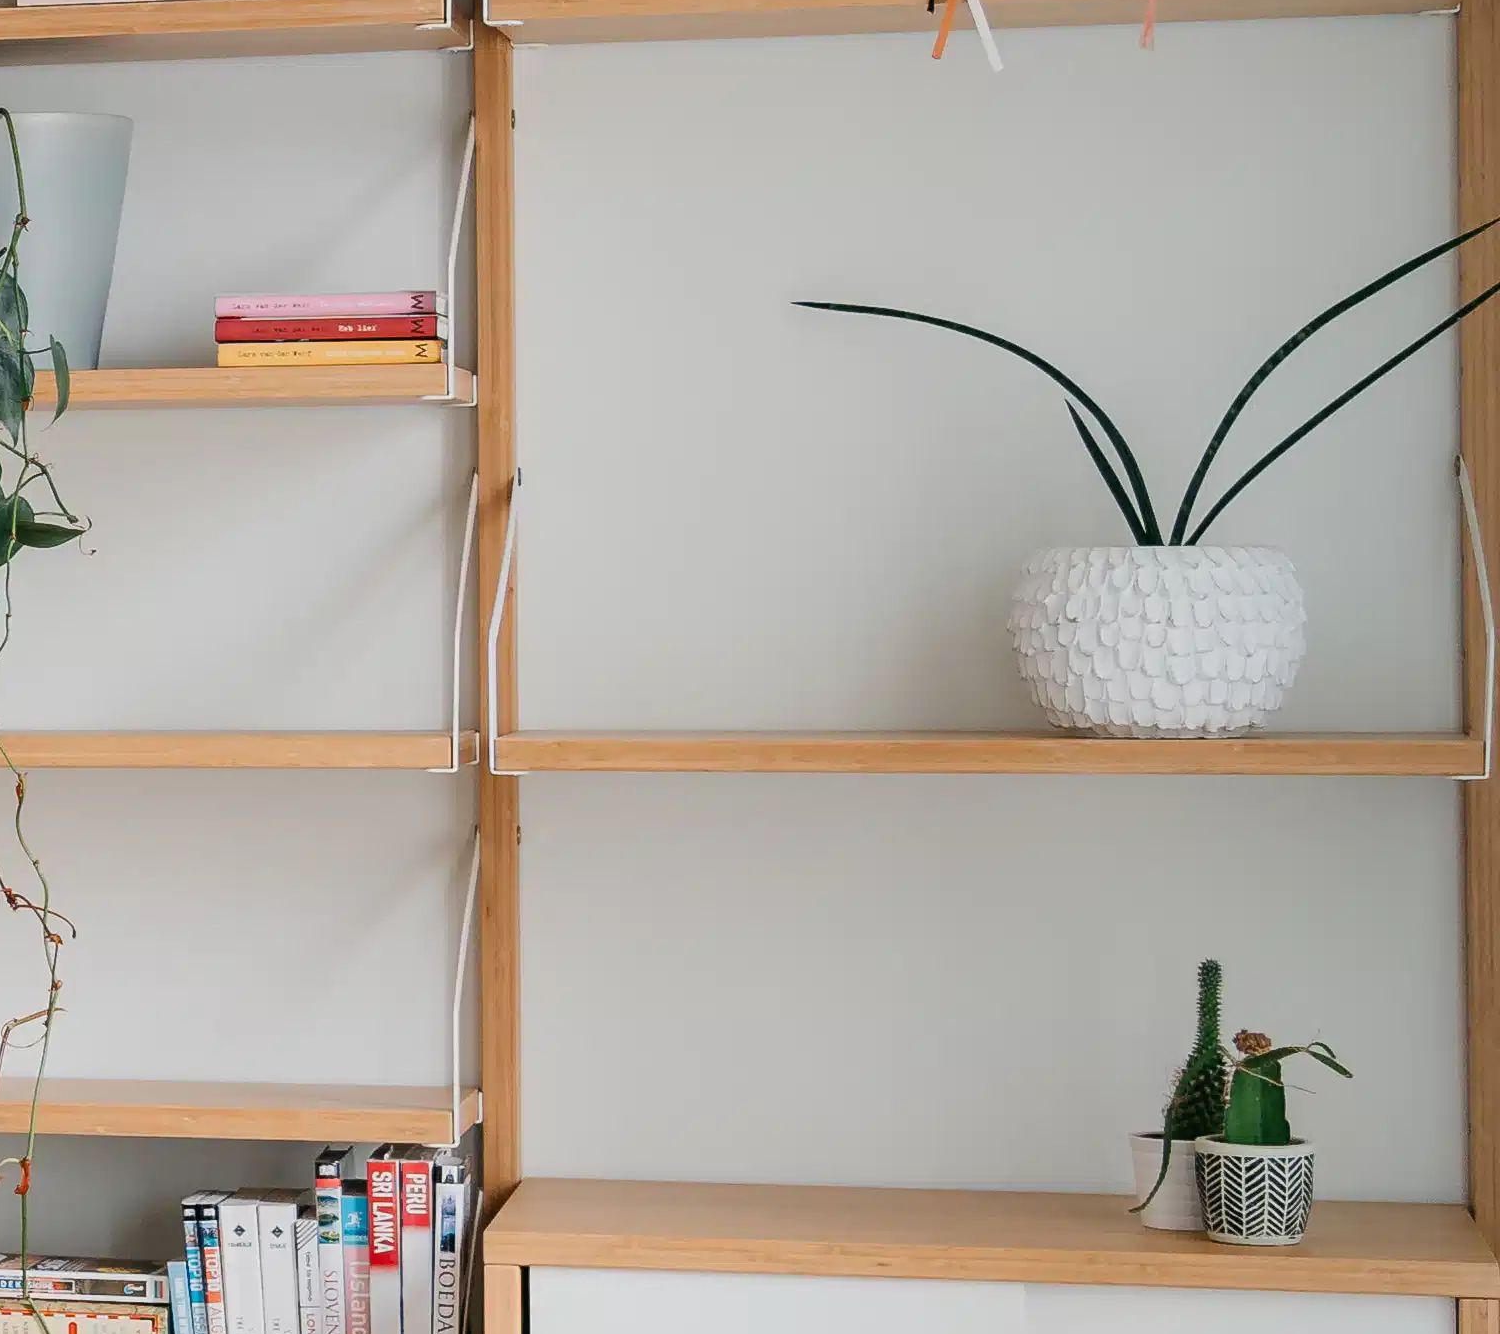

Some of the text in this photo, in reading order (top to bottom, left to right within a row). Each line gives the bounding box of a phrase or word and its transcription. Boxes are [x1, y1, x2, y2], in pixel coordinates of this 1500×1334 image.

[372, 1171, 395, 1255] SRI LANKA
[405, 1172, 428, 1215] PERU
